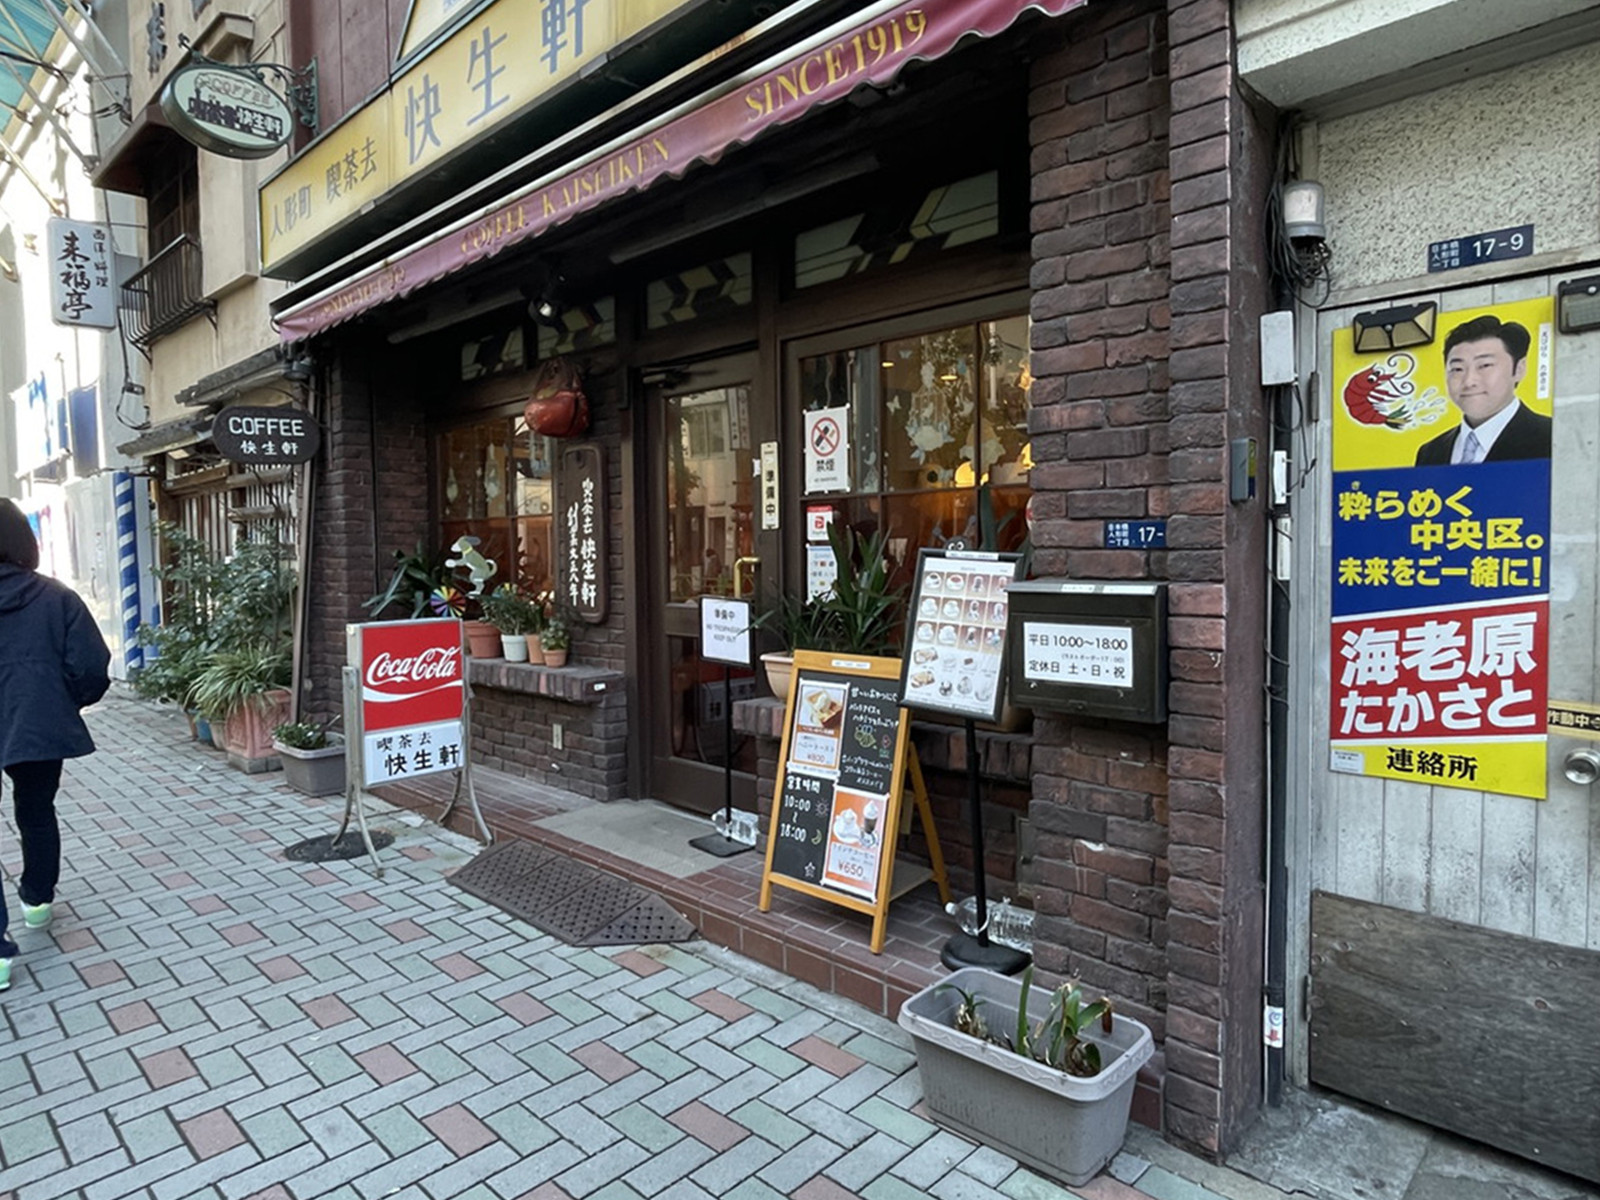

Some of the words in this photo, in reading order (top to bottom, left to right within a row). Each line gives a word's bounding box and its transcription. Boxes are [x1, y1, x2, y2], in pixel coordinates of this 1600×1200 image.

[404, 0, 590, 167] 快生軒
[1473, 233, 1524, 257] 17-9
[228, 416, 305, 437] COFFEE
[240, 440, 299, 455] 快生軒
[1338, 487, 1473, 521] 粋らめく
[1411, 518, 1544, 550] 中央区。
[1338, 556, 1542, 588] 未来をご一緒に!
[1029, 634, 1049, 646] 平日
[1340, 612, 1537, 686] 海老原
[366, 646, 461, 686] Coca-Cola
[1029, 660, 1060, 673] 定休日
[1340, 679, 1536, 735] たかさと
[377, 731, 432, 752] 喫茶去
[384, 744, 460, 776] 快生軒
[1386, 747, 1478, 781] 連絡所
[784, 794, 811, 812] 10:00
[781, 823, 807, 842] 18:00
